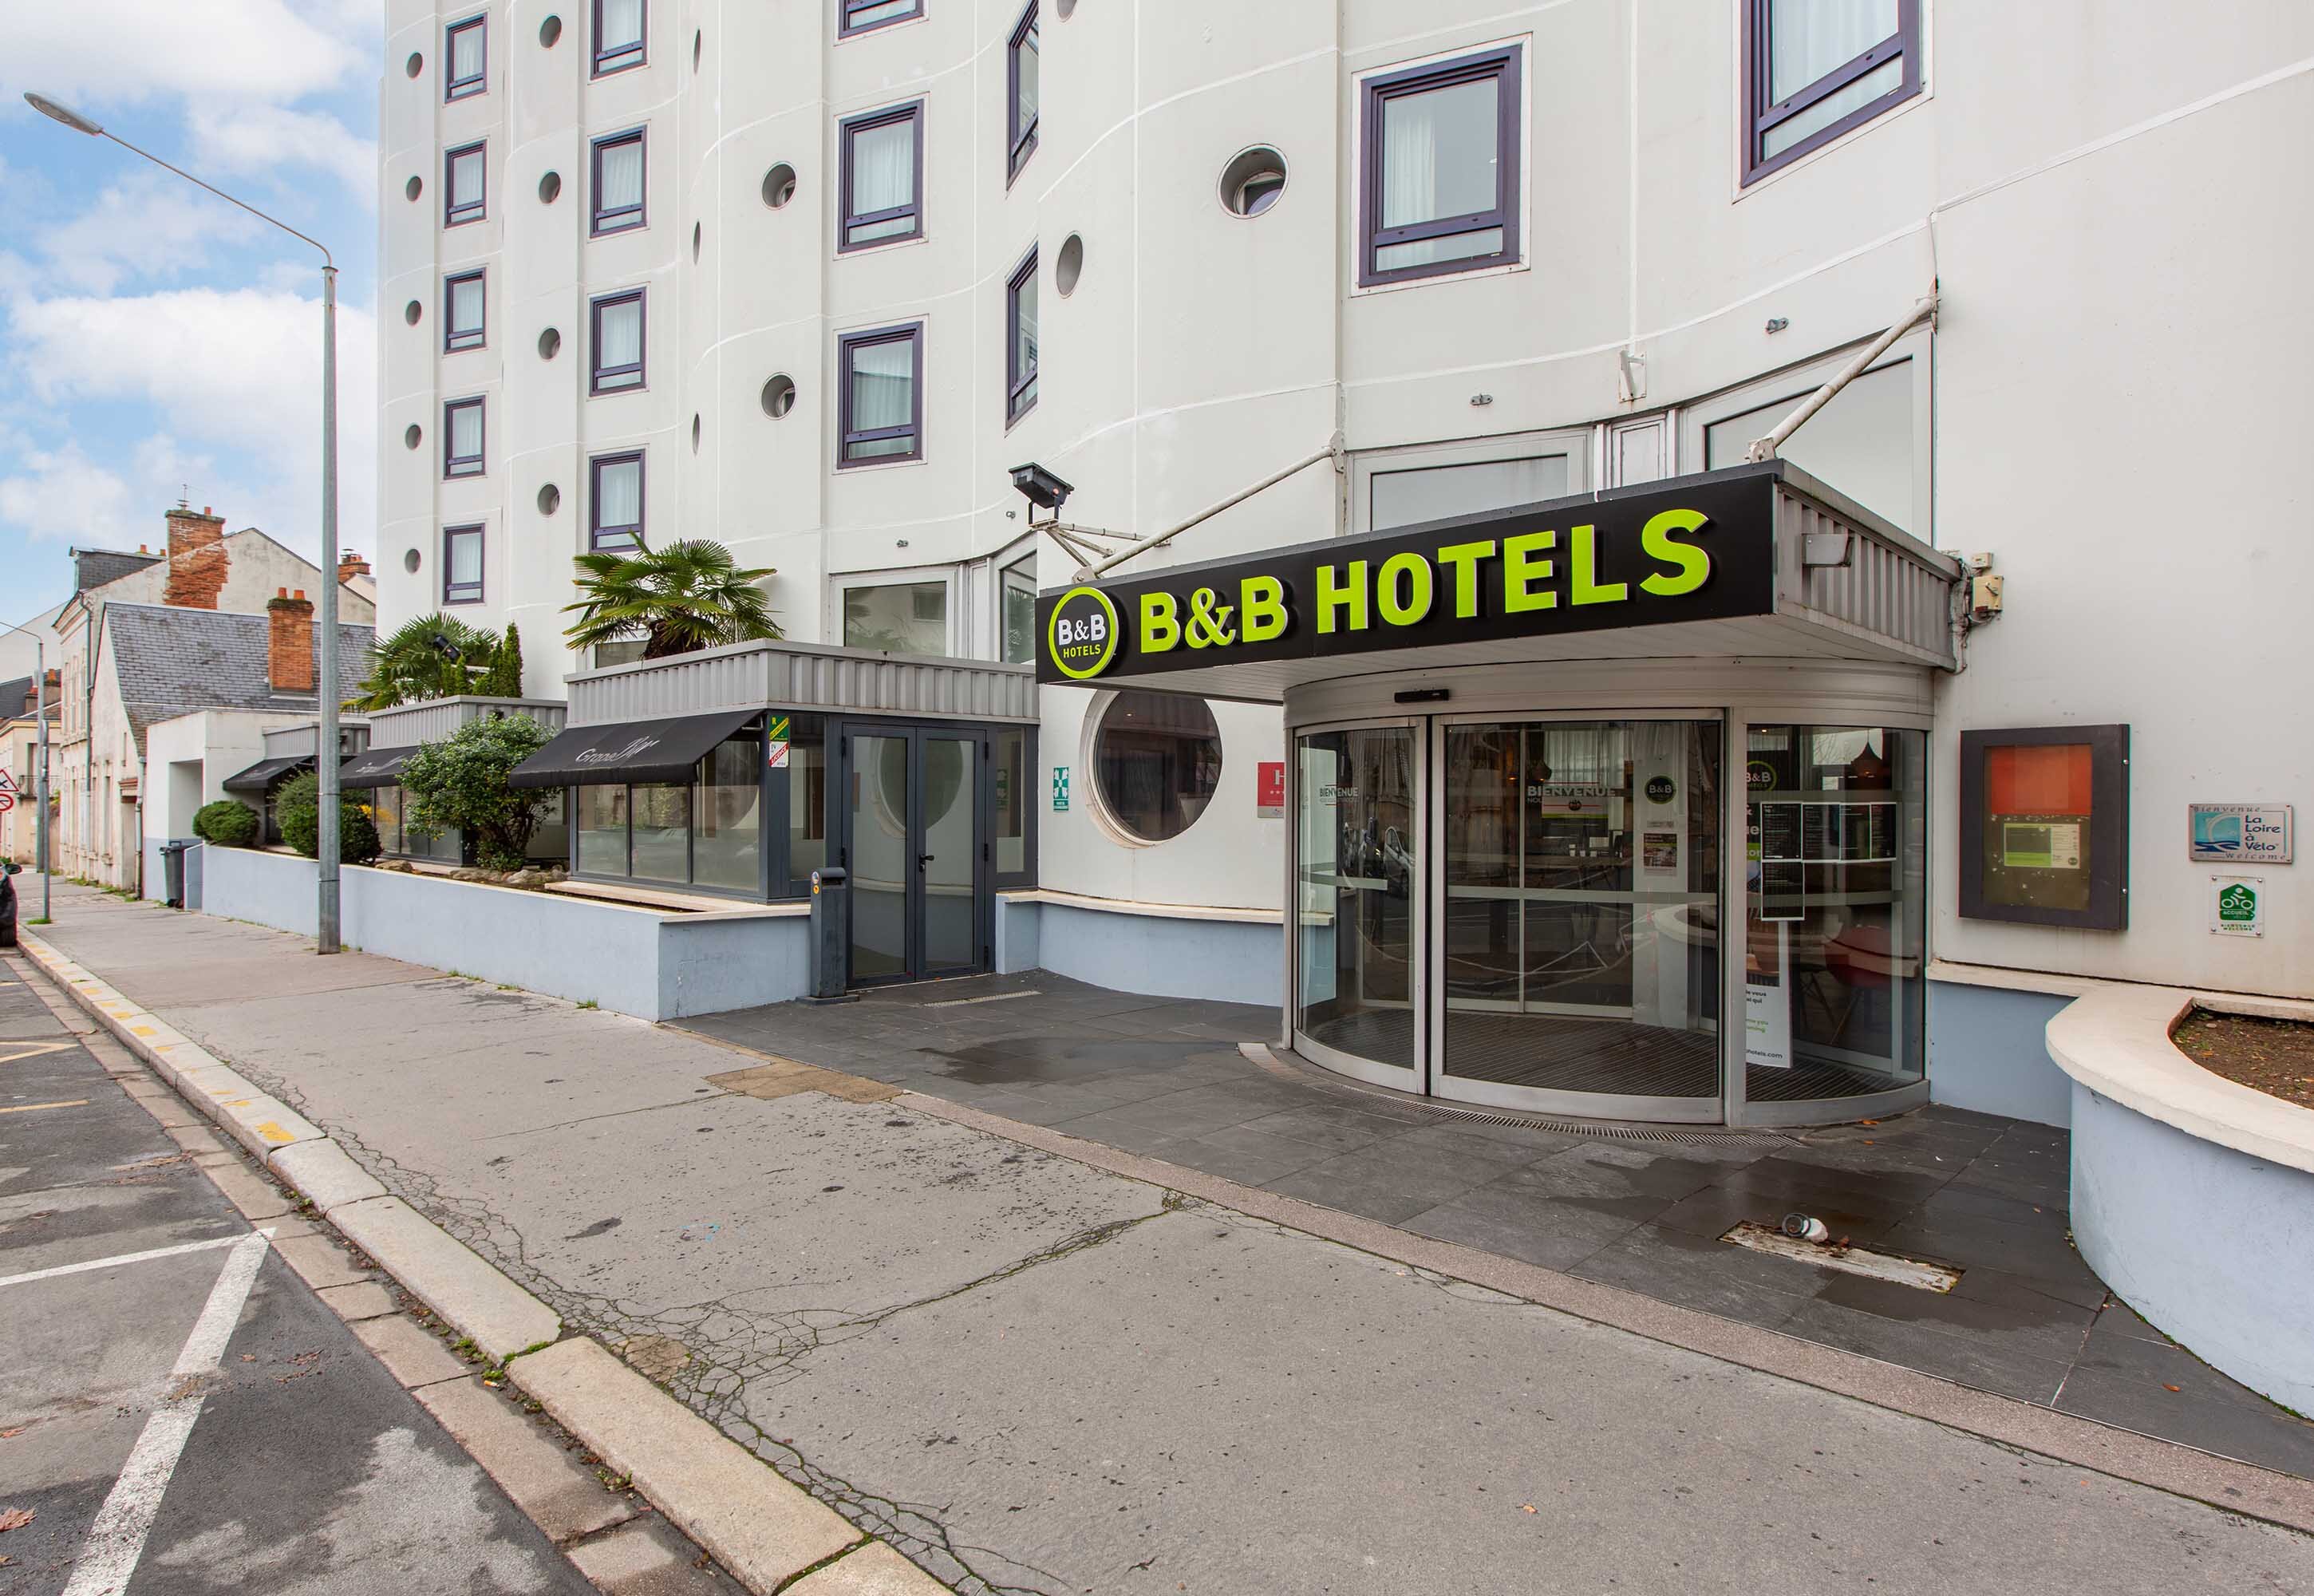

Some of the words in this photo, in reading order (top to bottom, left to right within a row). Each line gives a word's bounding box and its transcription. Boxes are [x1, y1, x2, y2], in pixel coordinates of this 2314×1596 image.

[1139, 575, 1290, 654] B&B
[1316, 508, 1711, 634] HOTELS
[1058, 614, 1106, 646] B&B
[1063, 644, 1101, 658] HOTELS
[1320, 787, 1359, 797] BIENVENUE
[1527, 785, 1616, 797] BIENVENUE
[1649, 784, 1672, 793] B&B
[2245, 815, 2261, 824] La
[2245, 824, 2281, 833] Loire
[2245, 842, 2276, 851] Vélo
